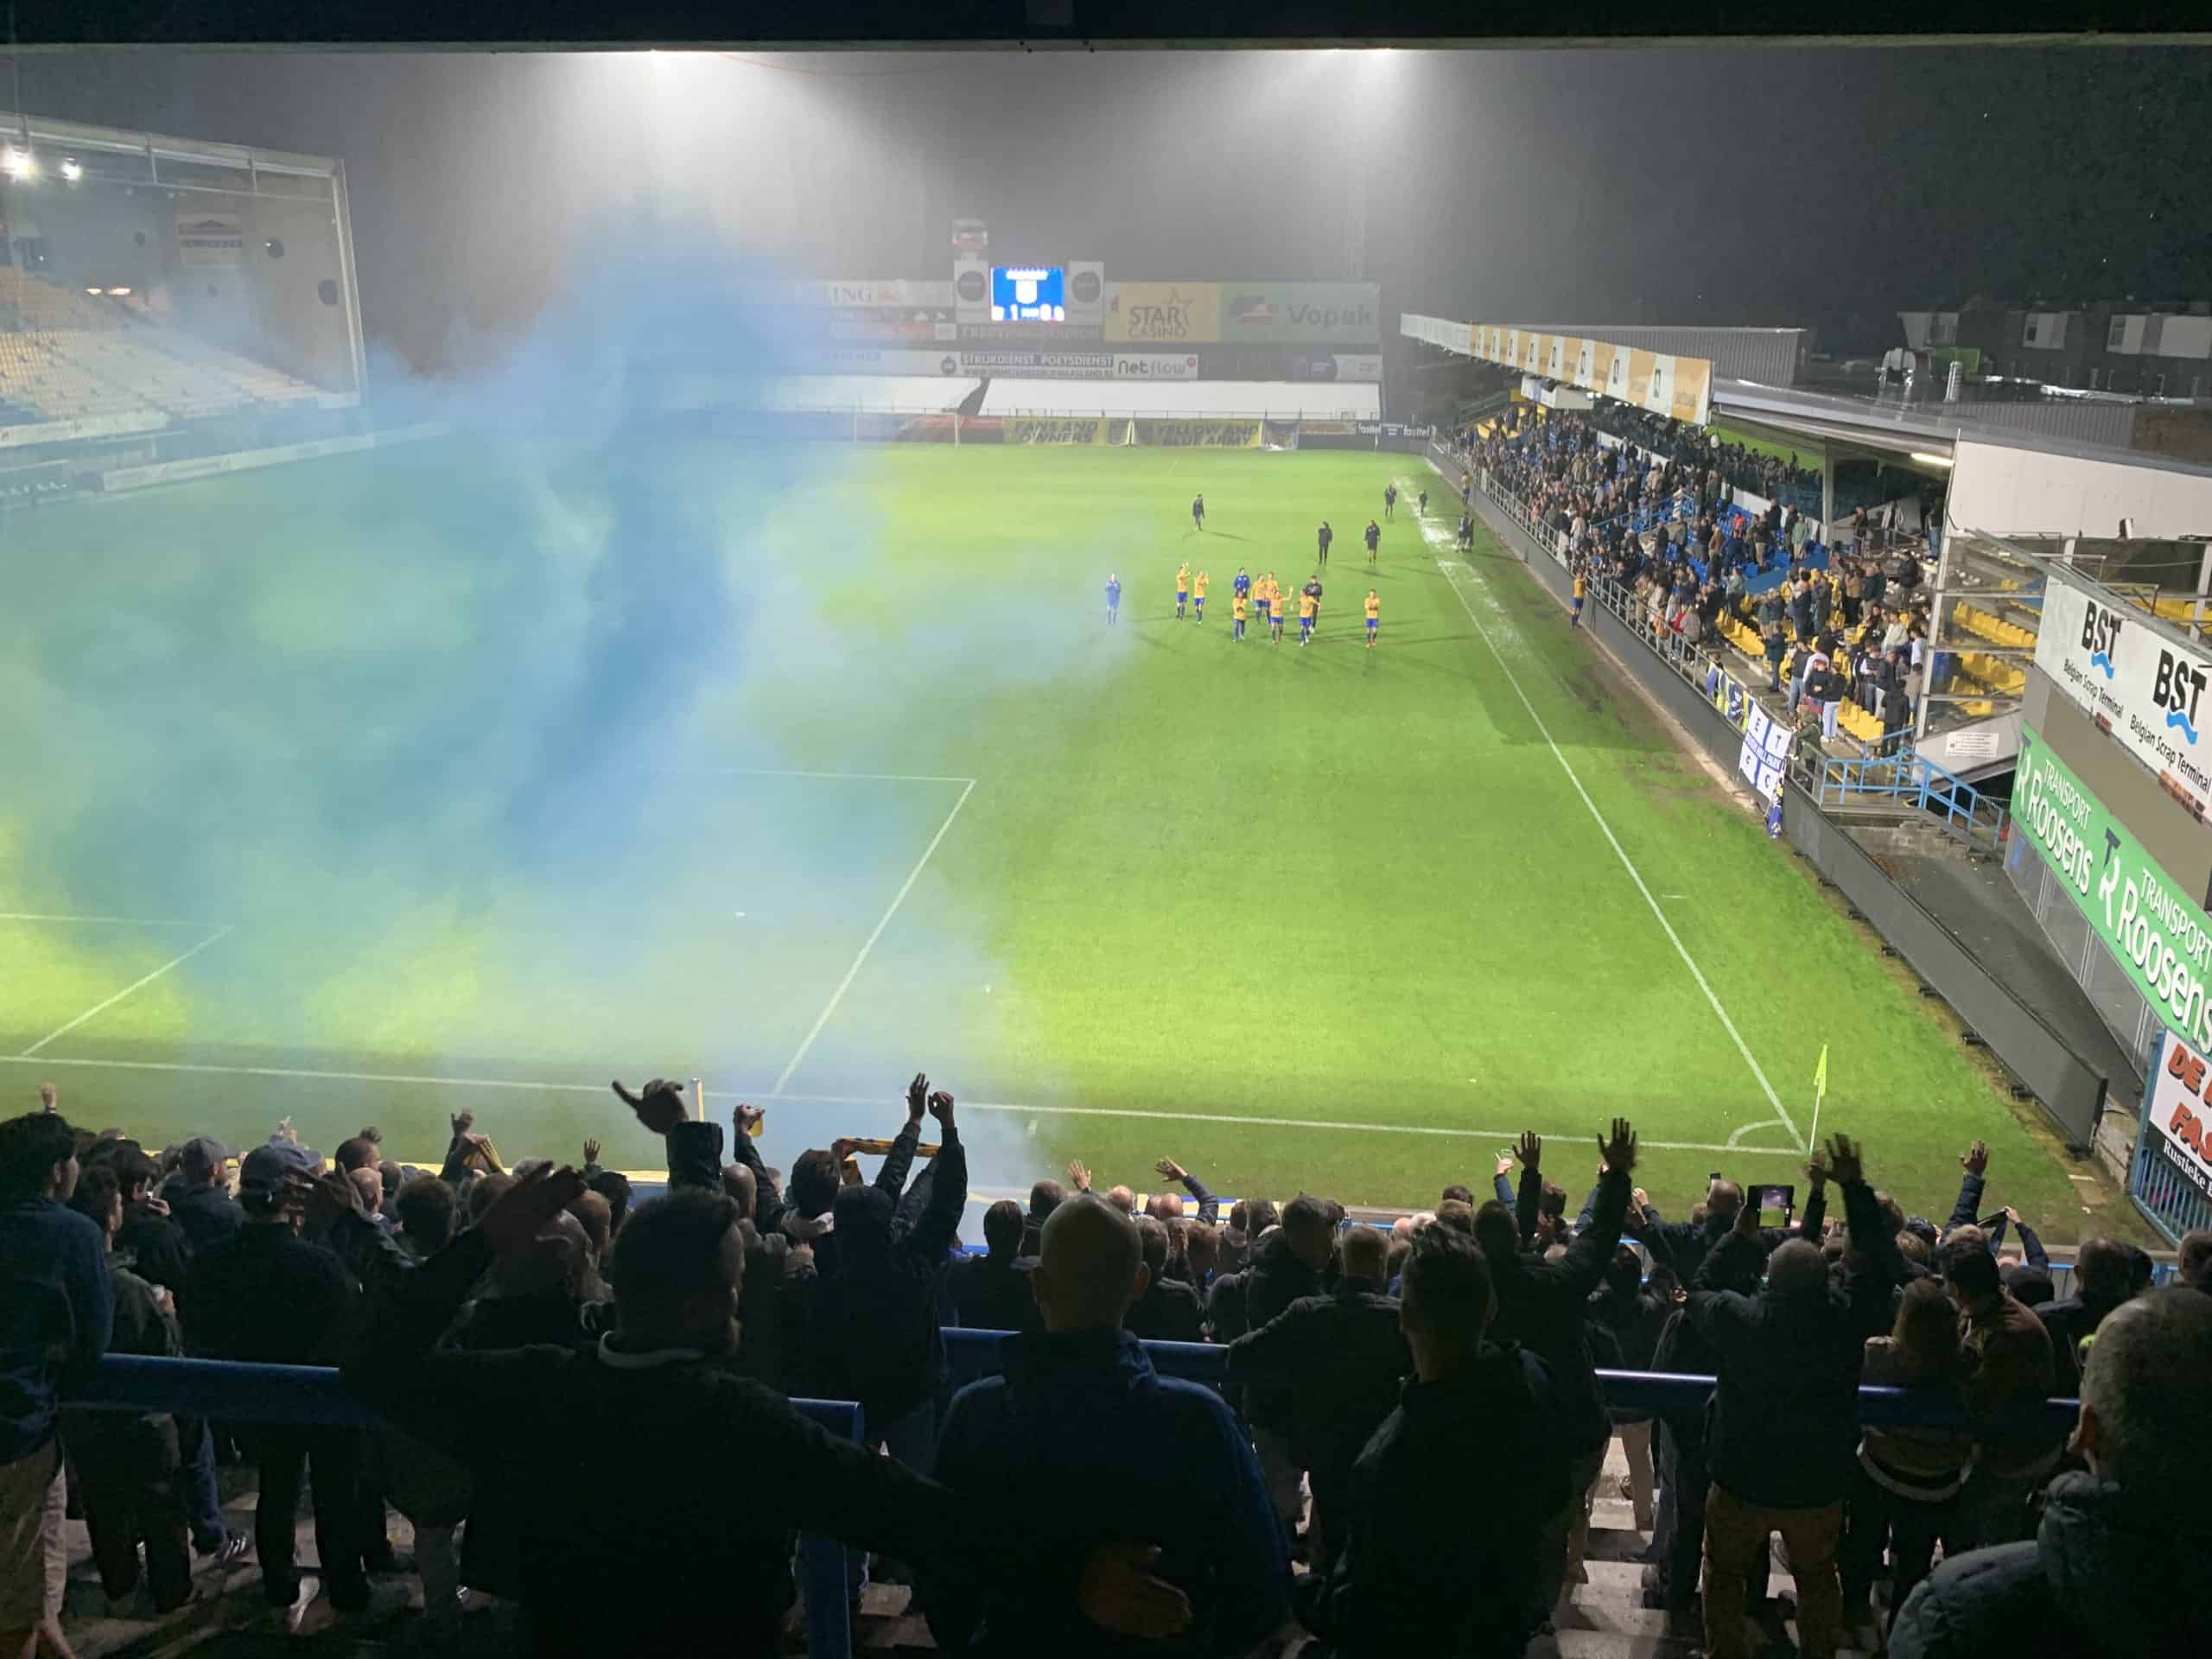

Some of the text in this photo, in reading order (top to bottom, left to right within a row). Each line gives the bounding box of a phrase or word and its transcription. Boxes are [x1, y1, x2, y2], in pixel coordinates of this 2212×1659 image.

[830, 288, 872, 304] ING
[1287, 303, 1375, 331] Vopak
[1128, 325, 1189, 340] CASINO
[2082, 600, 2122, 664] BST
[2063, 658, 2124, 719] Belgian Scrap Terminal
[2152, 649, 2207, 727] BST
[2129, 715, 2156, 747] Belgian
[2156, 735, 2177, 766] Scrap
[2177, 753, 2212, 794] Terminal
[2044, 758, 2092, 830] TRANSPORT
[2140, 867, 2212, 973] TRANSPORT
[2168, 1043, 2206, 1096] DE
